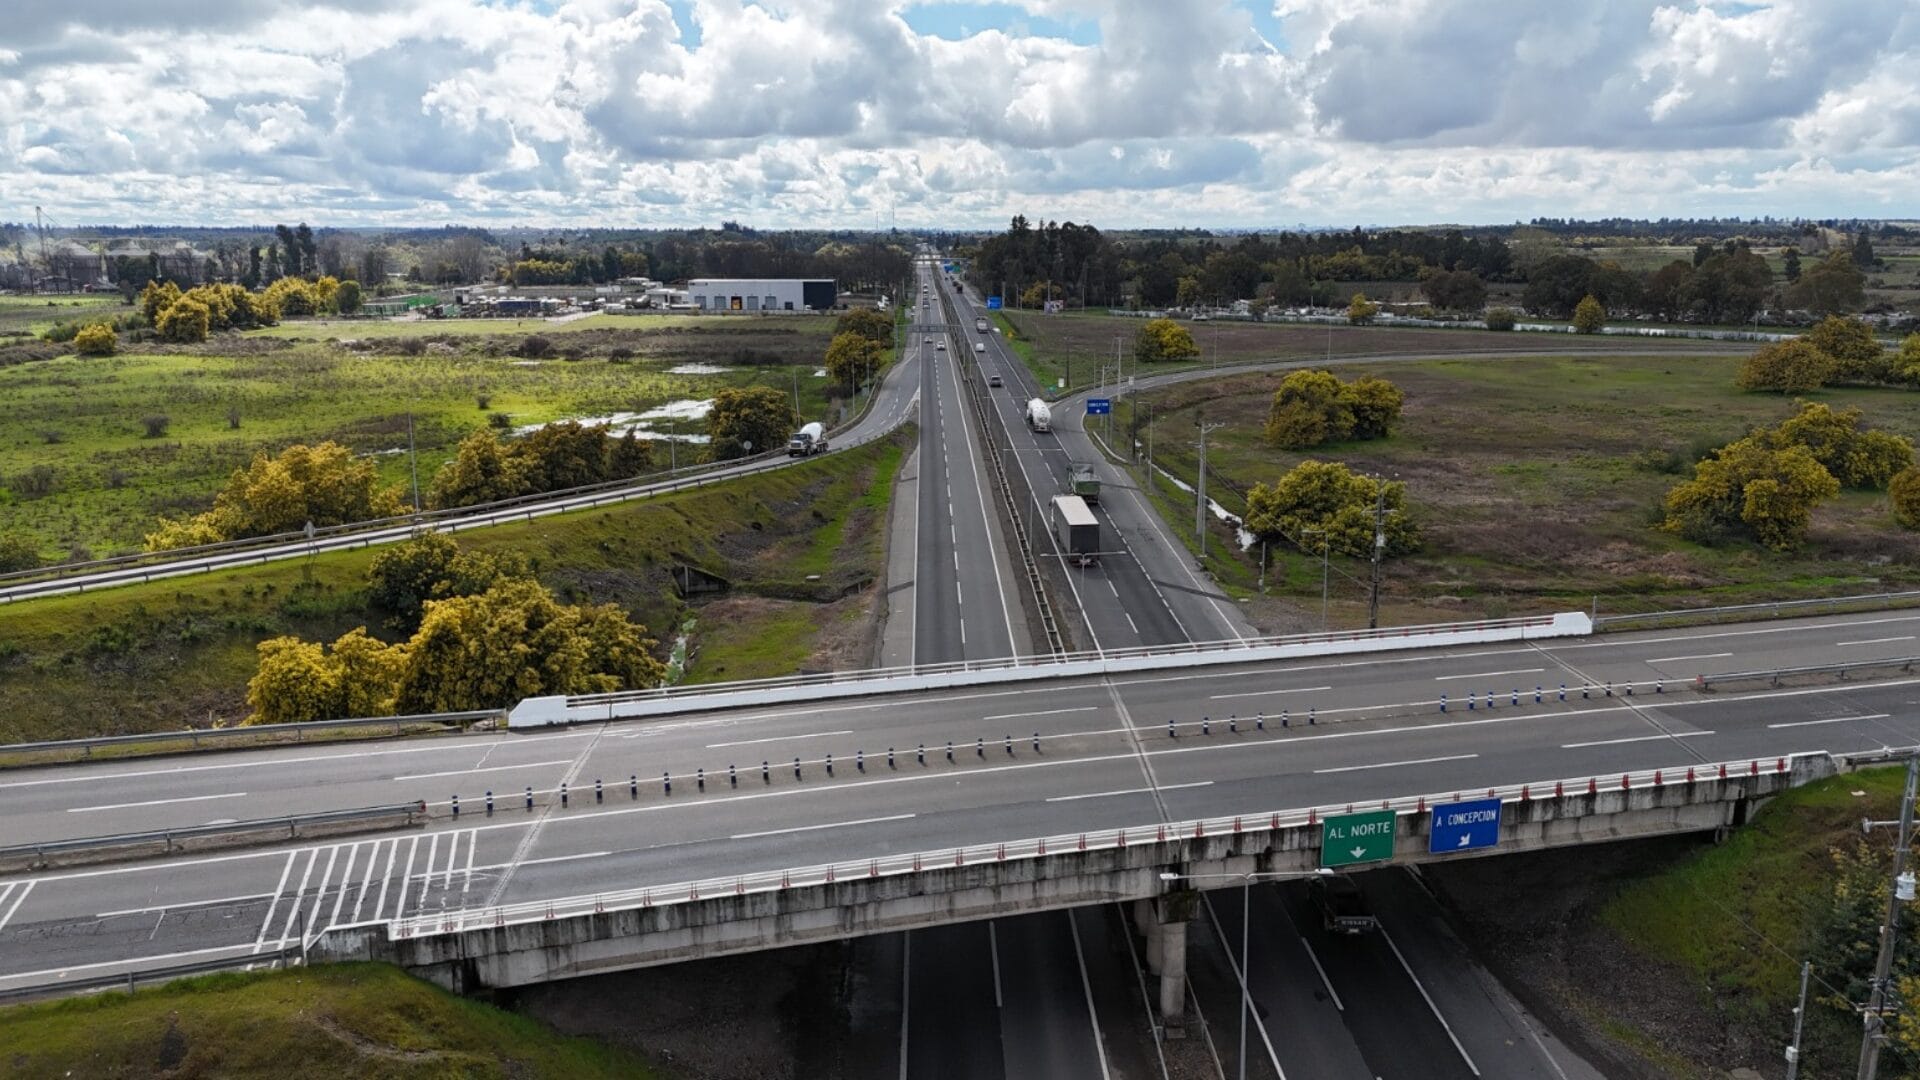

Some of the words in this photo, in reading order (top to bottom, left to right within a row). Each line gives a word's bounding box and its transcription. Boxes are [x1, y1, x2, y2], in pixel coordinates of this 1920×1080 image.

[1436, 816, 1442, 828] A
[1447, 809, 1496, 825] CONCEPCION
[1328, 827, 1345, 839] AL
[1350, 821, 1391, 837] NORTE
